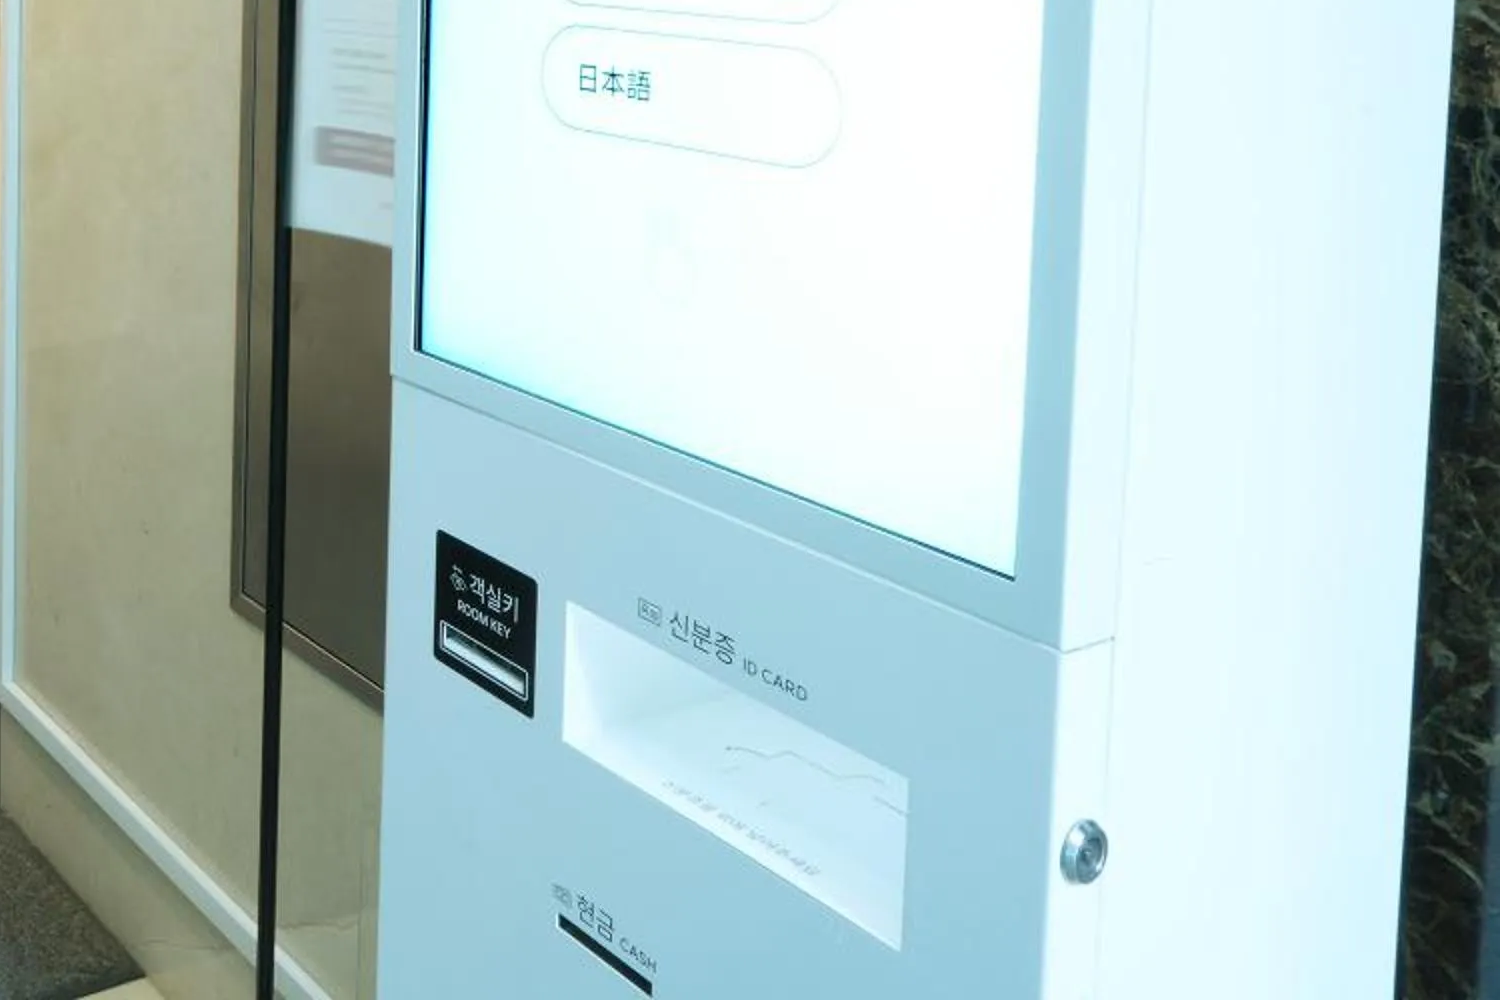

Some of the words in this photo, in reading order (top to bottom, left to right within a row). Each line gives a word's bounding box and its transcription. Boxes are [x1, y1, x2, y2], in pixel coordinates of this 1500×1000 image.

[578, 63, 652, 102] 日本語
[456, 599, 489, 627] ROOM
[489, 618, 512, 640] KEY
[469, 573, 520, 624] 객실키
[668, 611, 737, 666] 신분증
[742, 657, 758, 677] ID
[760, 668, 809, 702] CARD
[576, 892, 615, 943] 현금
[619, 936, 658, 973] CASH
